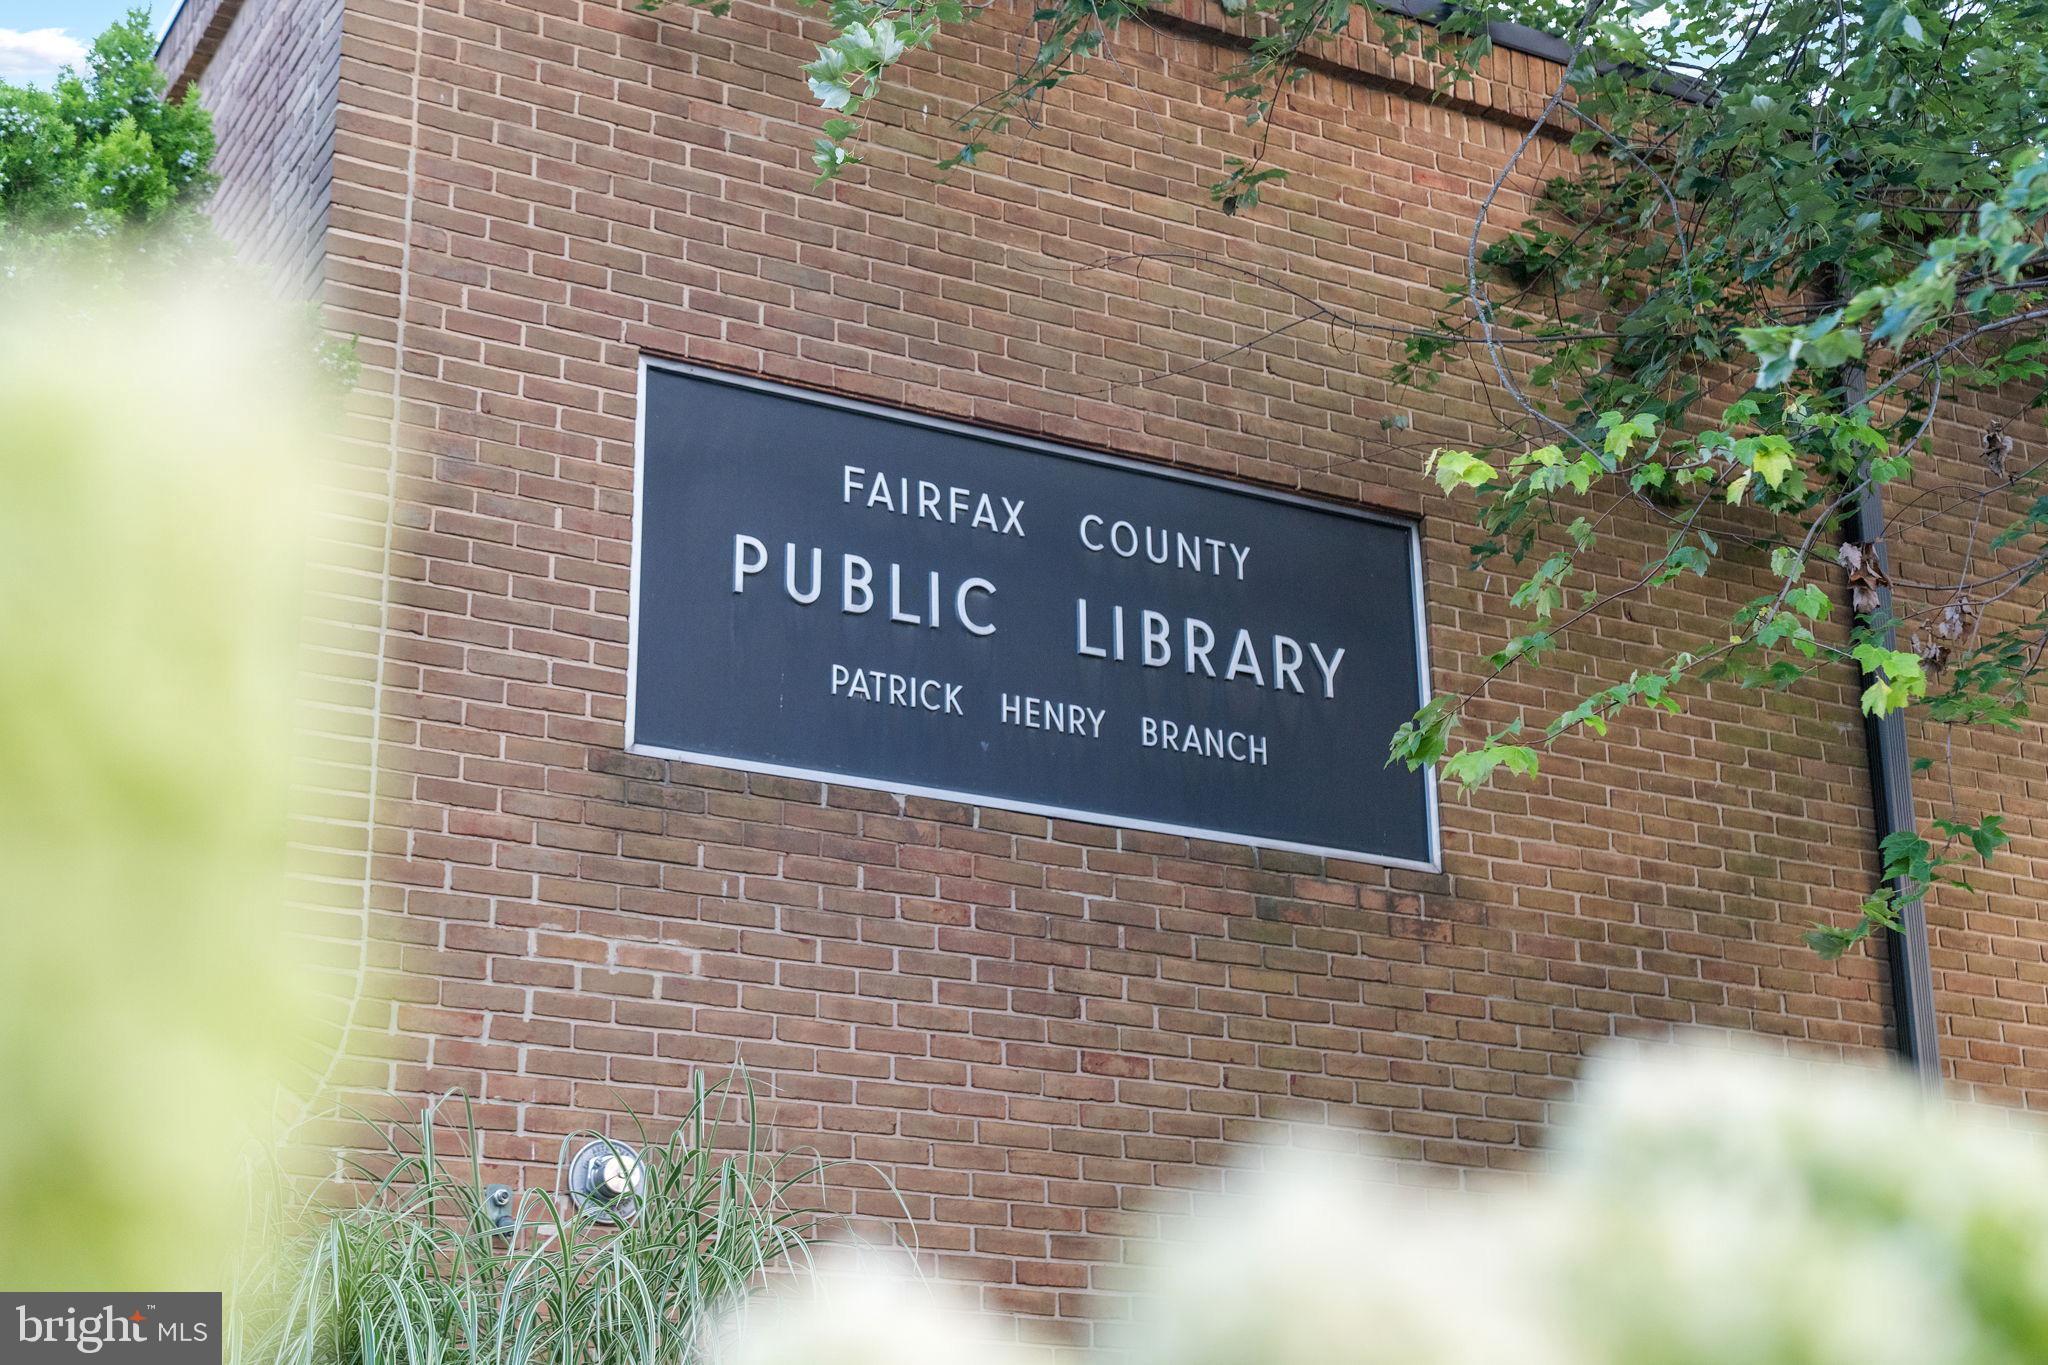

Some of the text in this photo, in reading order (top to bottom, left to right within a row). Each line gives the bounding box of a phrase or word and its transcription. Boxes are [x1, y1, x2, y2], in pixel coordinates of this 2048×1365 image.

[843, 465, 1251, 580] FAIRFAX COUNTY
[733, 533, 1346, 698] PUBLIC LIBRARY
[831, 663, 1268, 766] PATRICK HENRY BRANCH
